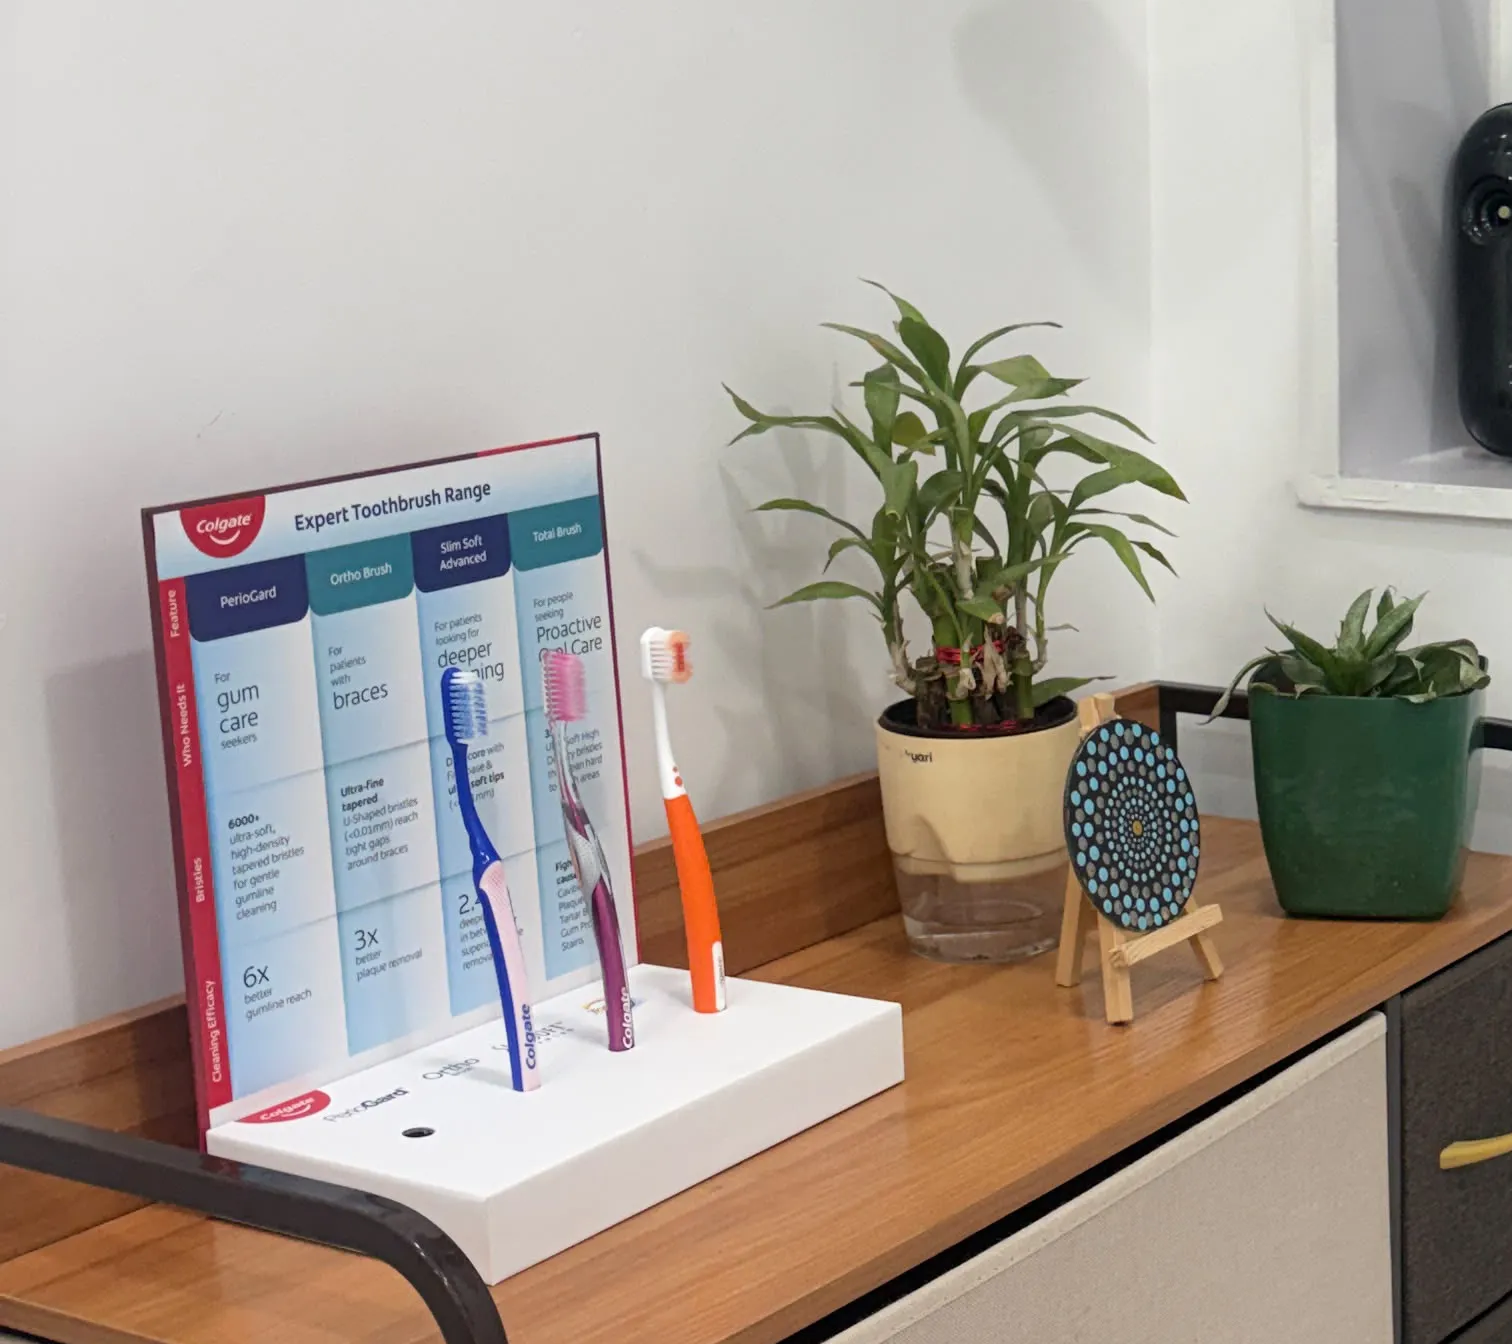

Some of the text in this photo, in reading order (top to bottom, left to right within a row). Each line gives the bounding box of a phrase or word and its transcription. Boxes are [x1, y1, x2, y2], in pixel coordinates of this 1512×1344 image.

[294, 482, 491, 532] Expert Toothbrush Range
[196, 514, 251, 534] Colgate
[532, 523, 582, 543] Total Brush
[440, 534, 483, 554] Slim Soft
[440, 551, 487, 571] Advanced
[330, 563, 392, 586] Ortho Brush
[220, 586, 277, 608] PerioGard
[533, 592, 574, 608] For people
[167, 589, 180, 638] Feature
[434, 614, 483, 632] For patients
[535, 608, 564, 622] seeking
[436, 628, 480, 646] looking for
[536, 615, 602, 643] Proactive
[328, 646, 343, 657] For
[437, 642, 493, 668] deeper
[571, 637, 603, 655] Care
[329, 655, 366, 674] patients
[214, 673, 230, 684] For
[331, 673, 351, 686] with
[217, 684, 260, 713] gum
[333, 683, 389, 710] braces
[178, 695, 189, 735] Needs
[219, 710, 259, 734] care
[182, 737, 192, 767] Who
[220, 733, 258, 750] seekers
[340, 778, 384, 797] Ultra-fine
[471, 771, 505, 788] soft tips
[341, 792, 378, 812] tapered
[343, 805, 386, 826] U-Shaped
[395, 811, 419, 827] reach
[368, 835, 391, 852] gaps
[232, 856, 270, 876] tapered
[347, 843, 408, 871] around braces
[193, 857, 205, 903] Bristles
[233, 869, 280, 891] for gentle
[235, 885, 275, 908] gumline
[236, 900, 277, 921] cleaning
[354, 928, 379, 951] 3x
[355, 950, 382, 966] better
[356, 948, 423, 982] plaque removal
[243, 965, 270, 988] 6x
[244, 987, 273, 1005] better
[245, 988, 313, 1022] gumline reach
[205, 980, 222, 1083] Cleaning Efficacy
[521, 1003, 537, 1070] Colgate
[422, 1058, 480, 1080] Ortho
[259, 1096, 315, 1121] Colgate
